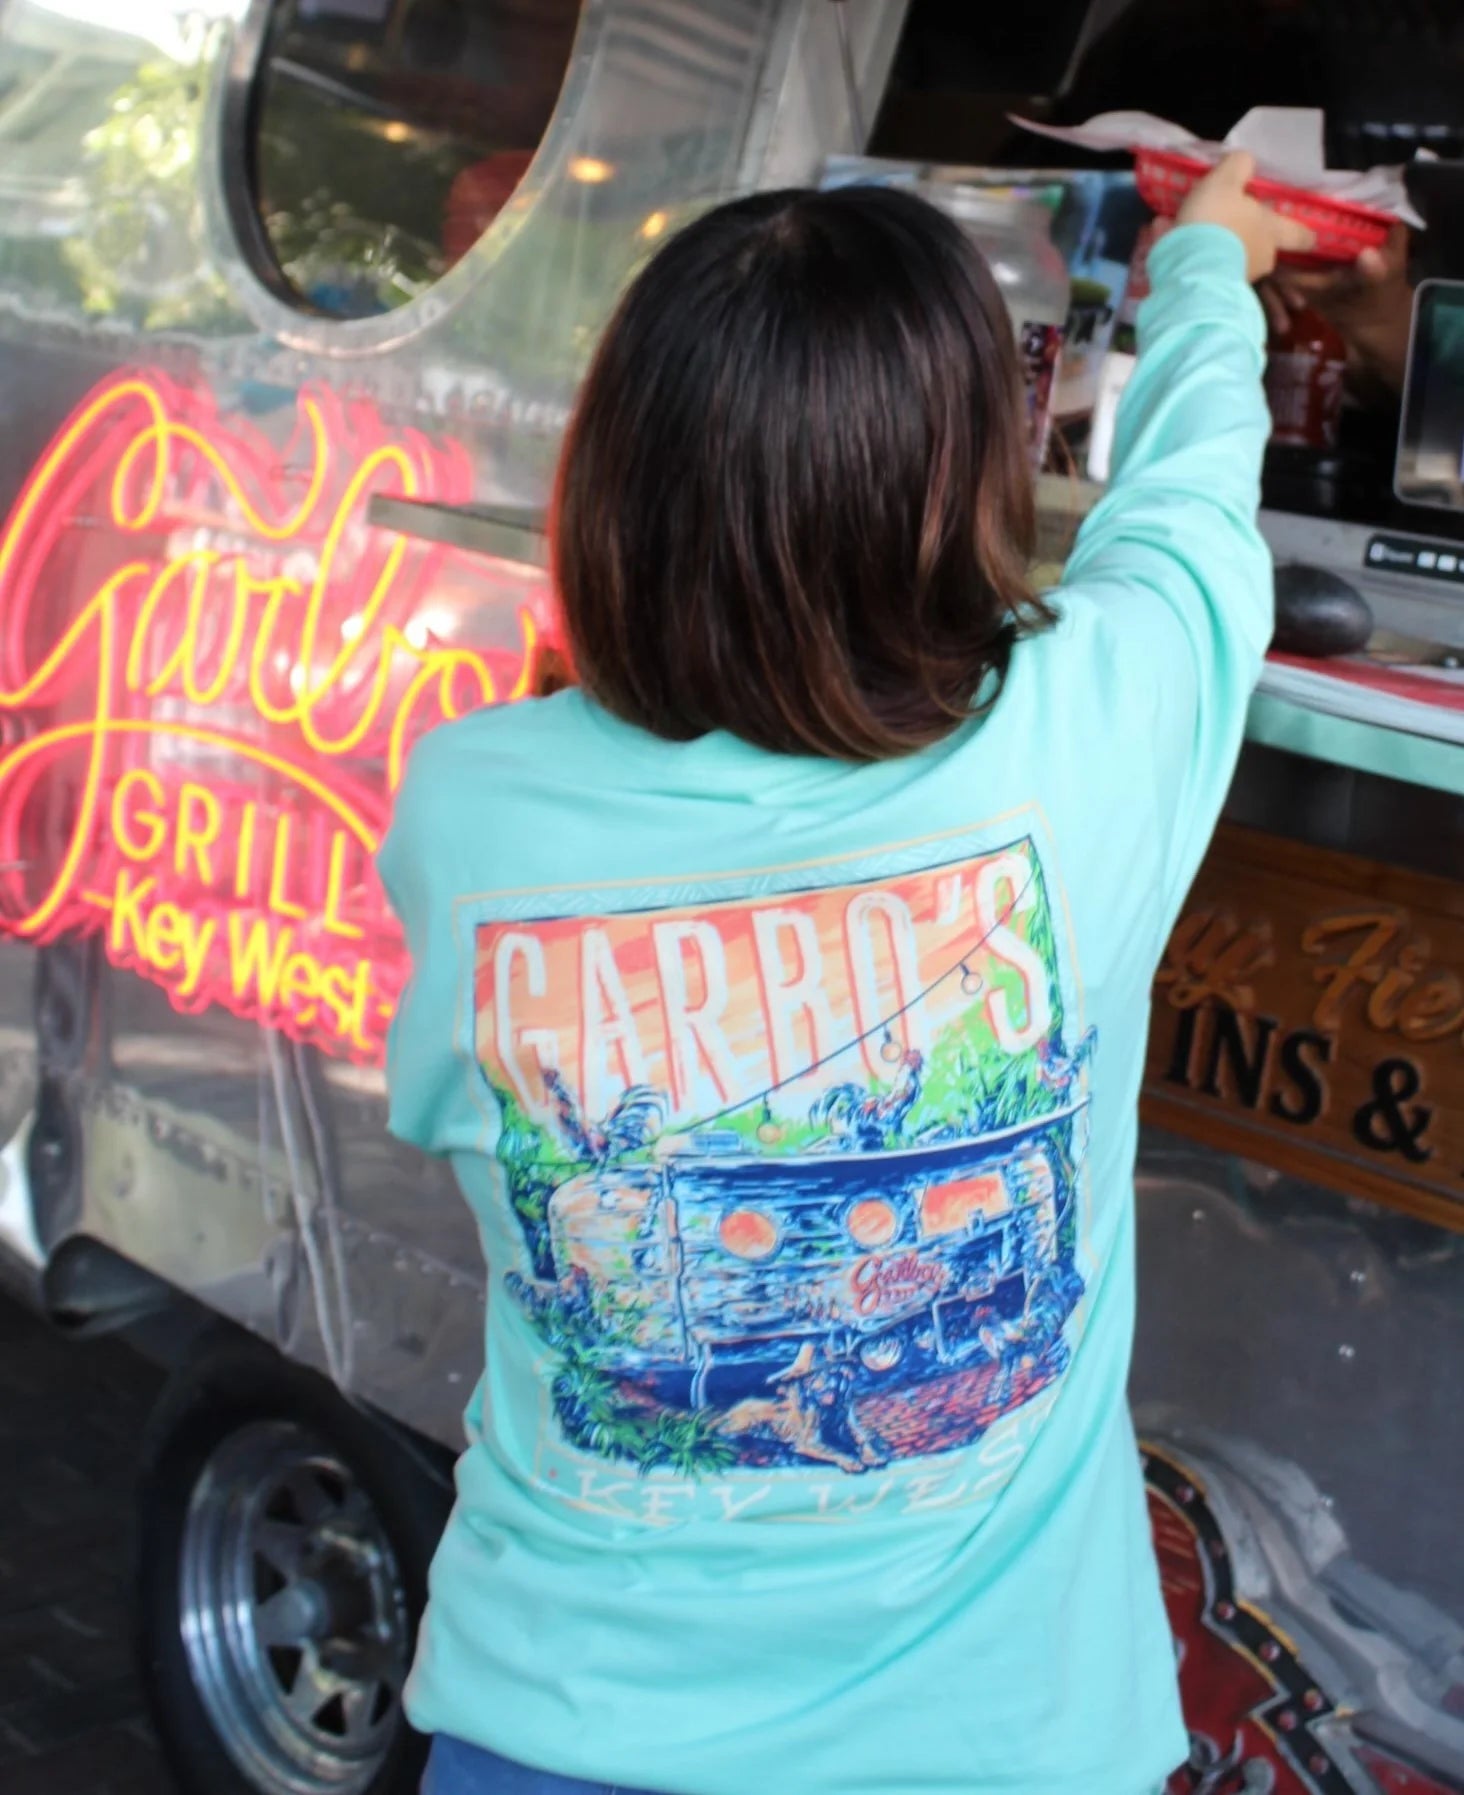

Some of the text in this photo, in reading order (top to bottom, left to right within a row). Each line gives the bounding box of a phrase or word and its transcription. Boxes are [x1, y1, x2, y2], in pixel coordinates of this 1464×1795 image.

[111, 768, 364, 940] GRILL
[110, 868, 375, 1051] Key West
[493, 851, 1053, 1132] GARBO'S
[1354, 1060, 1432, 1165] &
[809, 1416, 1038, 1514] WES
